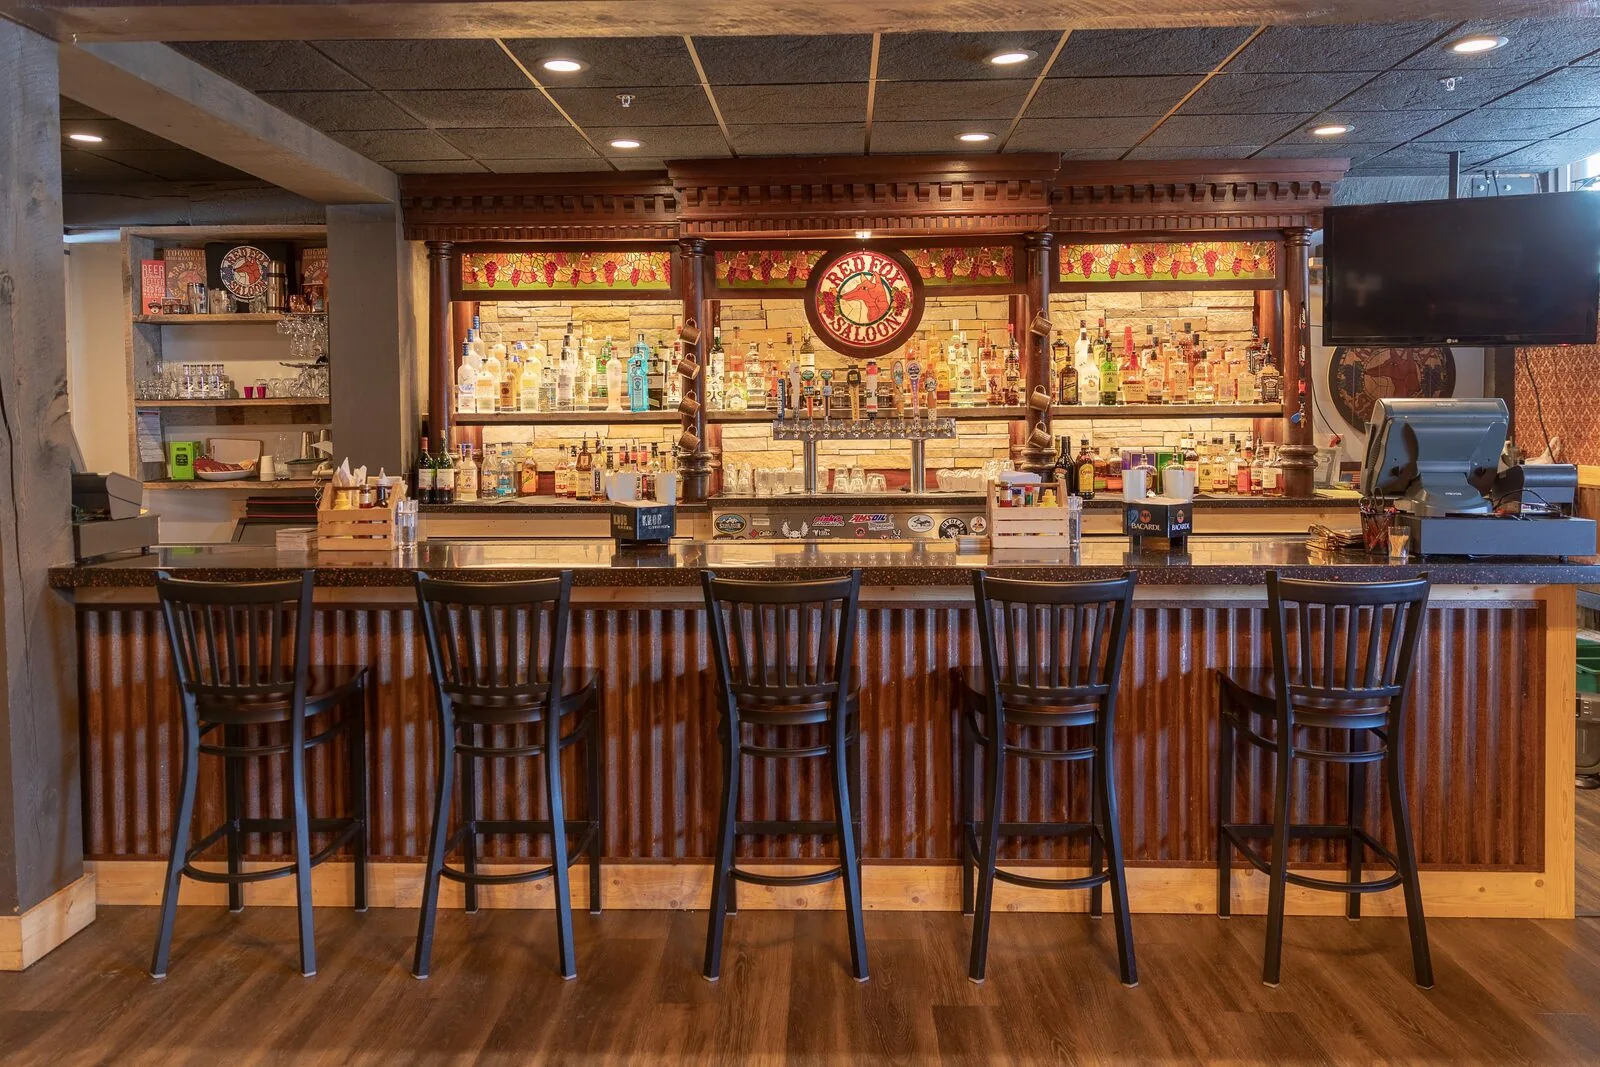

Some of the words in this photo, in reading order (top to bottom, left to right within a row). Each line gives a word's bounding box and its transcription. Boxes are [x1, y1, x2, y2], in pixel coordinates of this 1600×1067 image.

[226, 247, 248, 265] RED
[143, 264, 165, 279] BEER
[826, 256, 865, 287] RED
[869, 256, 904, 287] FOX
[829, 312, 902, 343] SALOON
[851, 514, 887, 523] AMSOIL
[1131, 522, 1160, 531] BACARDI
[1171, 523, 1190, 531] BACARDI
